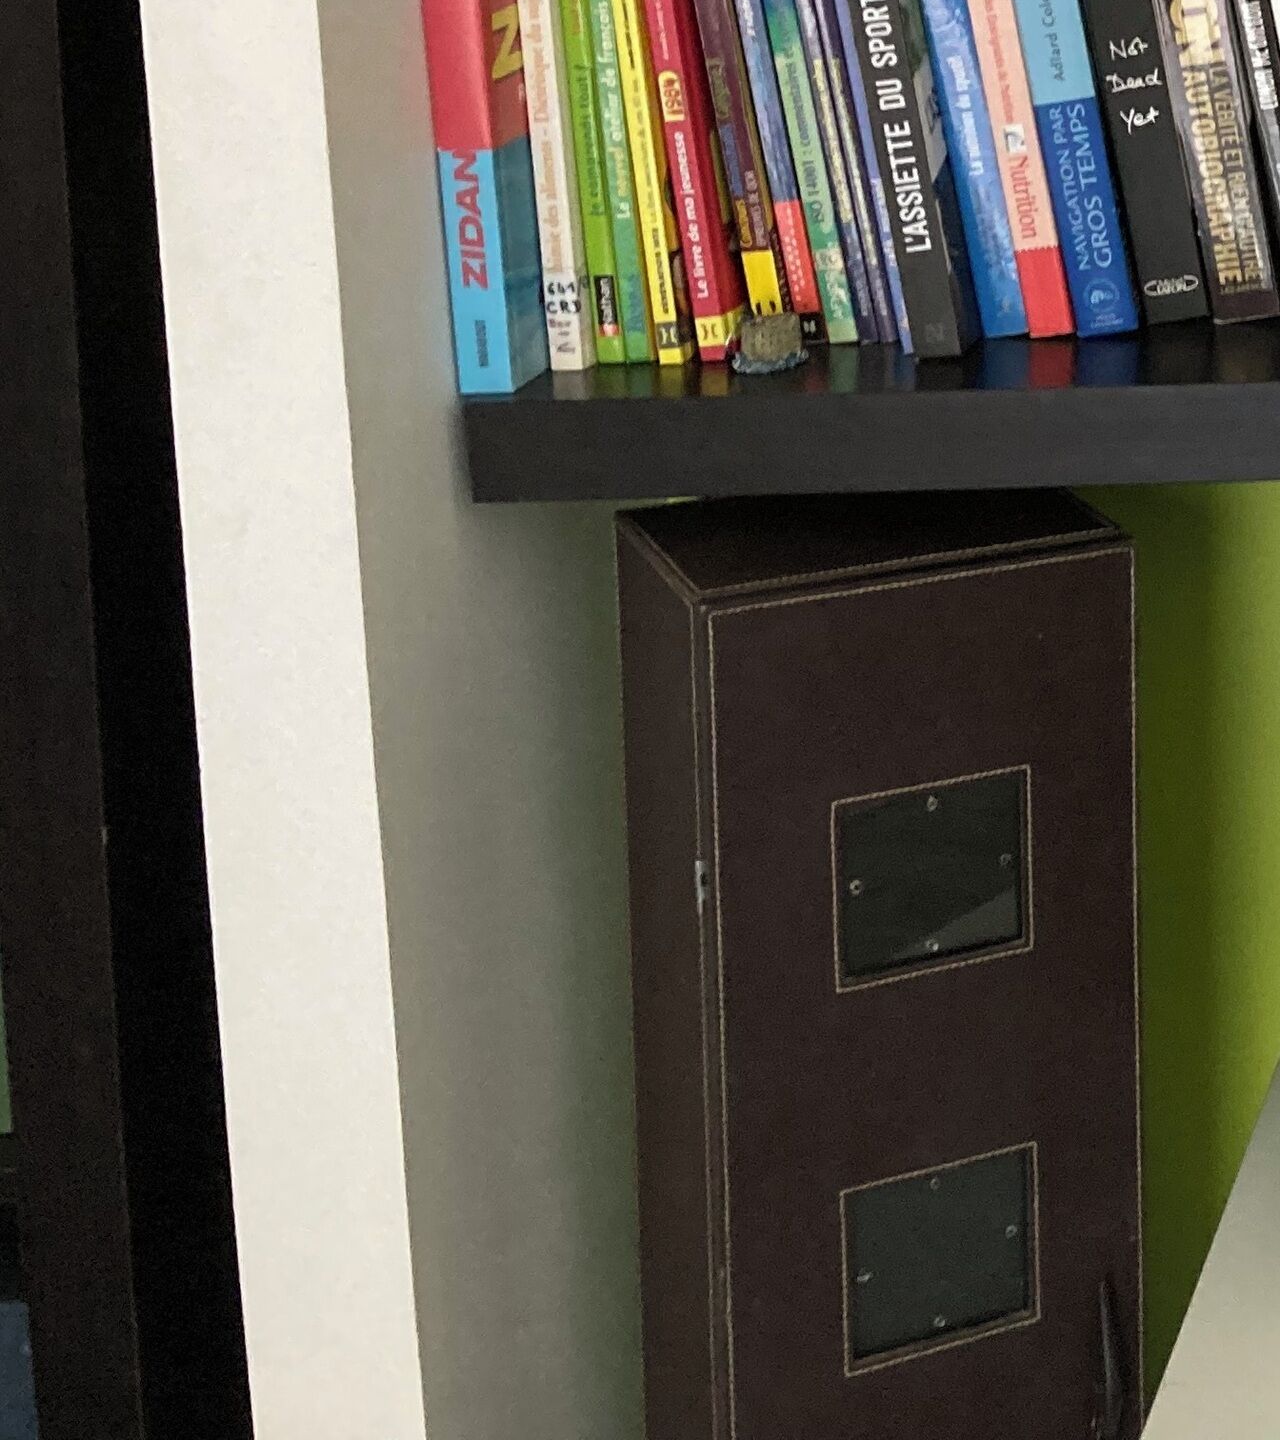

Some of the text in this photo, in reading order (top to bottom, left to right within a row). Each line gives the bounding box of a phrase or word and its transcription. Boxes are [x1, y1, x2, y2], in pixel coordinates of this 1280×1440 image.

[875, 78, 906, 110] DU
[1208, 64, 1228, 87] LA
[883, 120, 932, 252] L'ASSIETTE
[1008, 156, 1040, 239] Nutrition
[1049, 108, 1089, 270] NAVIGATION PAR
[1068, 102, 1114, 268] GROS TEMPS
[1181, 66, 1244, 284] AUTOBIOGRAPHIE
[1222, 148, 1244, 166] ET
[1227, 171, 1254, 209] RIEN
[673, 132, 709, 299] Le livre de ma jeunesse
